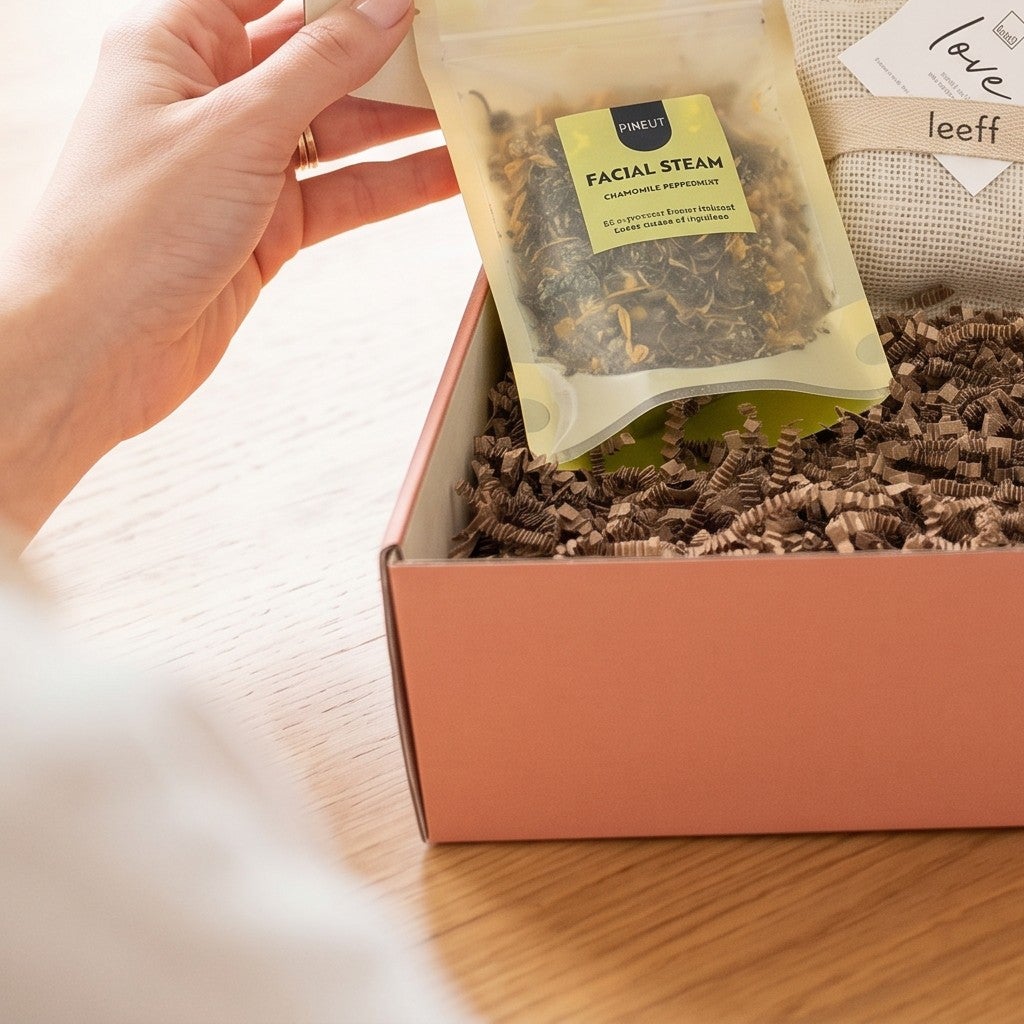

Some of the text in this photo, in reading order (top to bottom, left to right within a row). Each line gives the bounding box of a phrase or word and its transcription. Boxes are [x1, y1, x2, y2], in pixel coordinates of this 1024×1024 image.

[928, 16, 1012, 101] love
[618, 117, 665, 133] PINEUT
[928, 110, 1001, 145] leeff
[585, 156, 724, 187] FACIAL STEAM
[603, 184, 662, 201] CHAMOMILE
